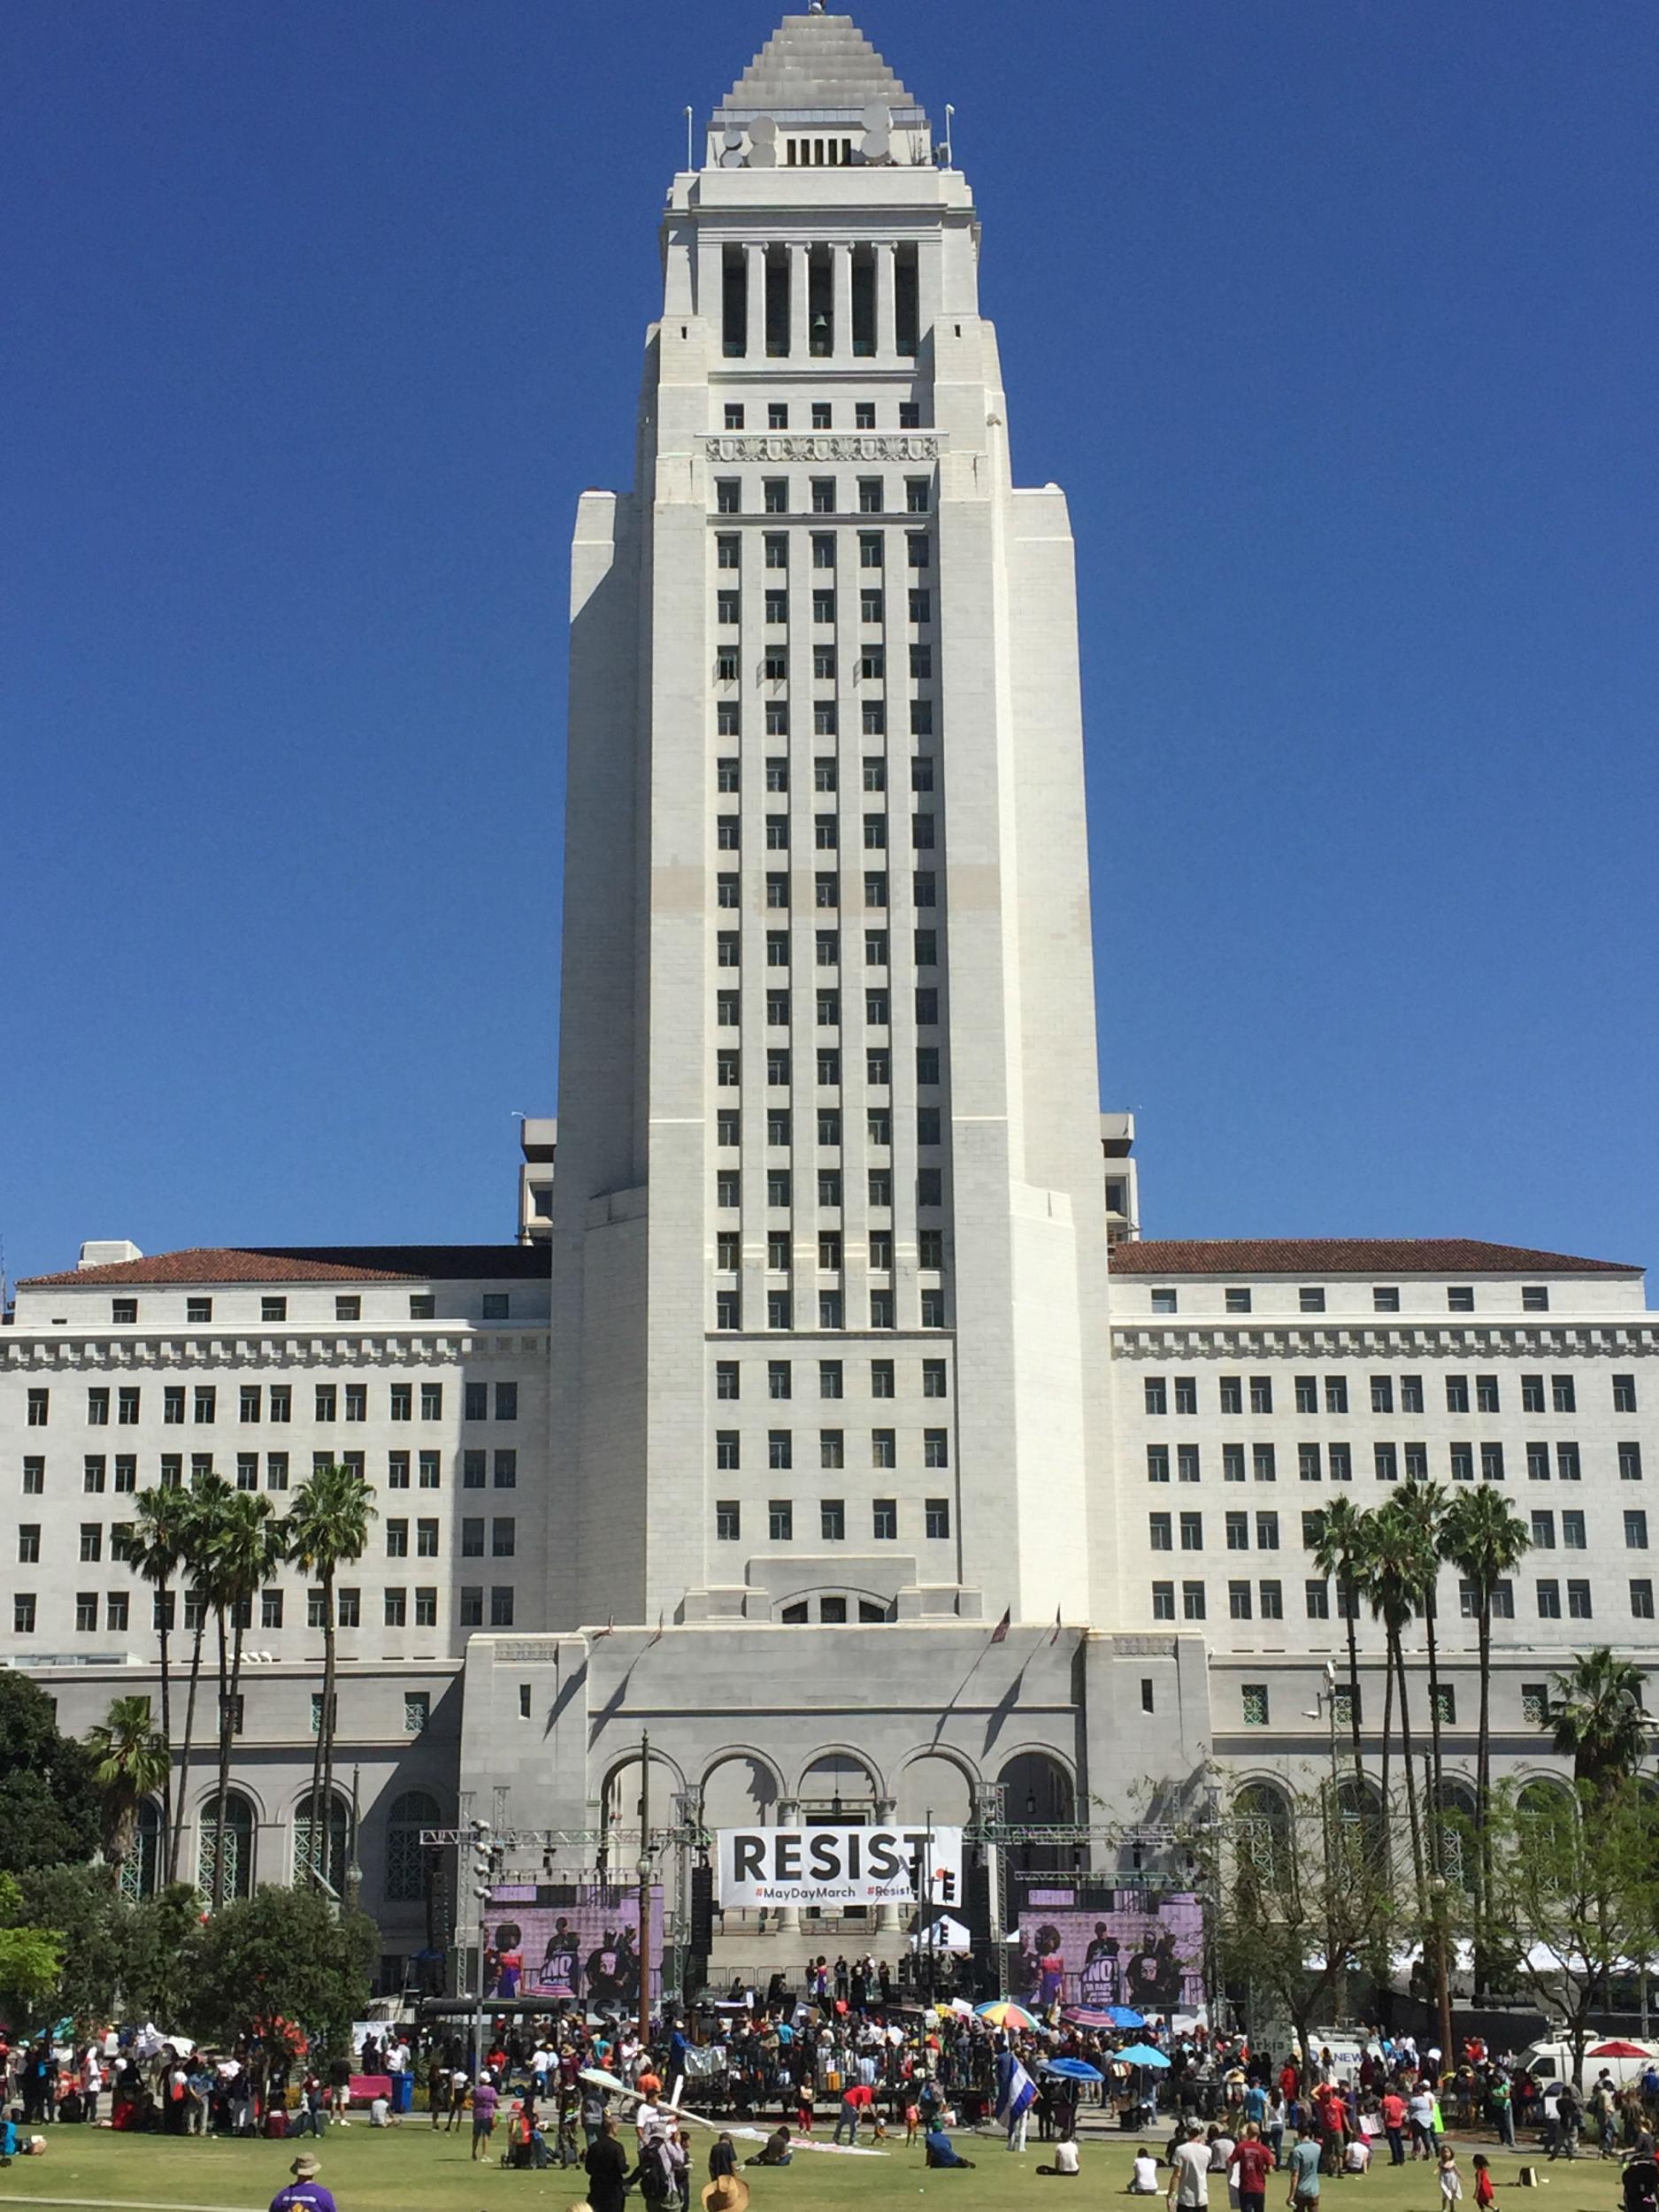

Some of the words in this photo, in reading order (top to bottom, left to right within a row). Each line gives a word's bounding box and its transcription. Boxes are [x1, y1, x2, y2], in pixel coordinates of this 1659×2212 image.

[734, 1834, 935, 1882] RESIST
[756, 1886, 856, 1901] #MayDayMarch
[868, 1886, 915, 1897] #Resist
[1333, 2052, 1363, 2062] NEW
